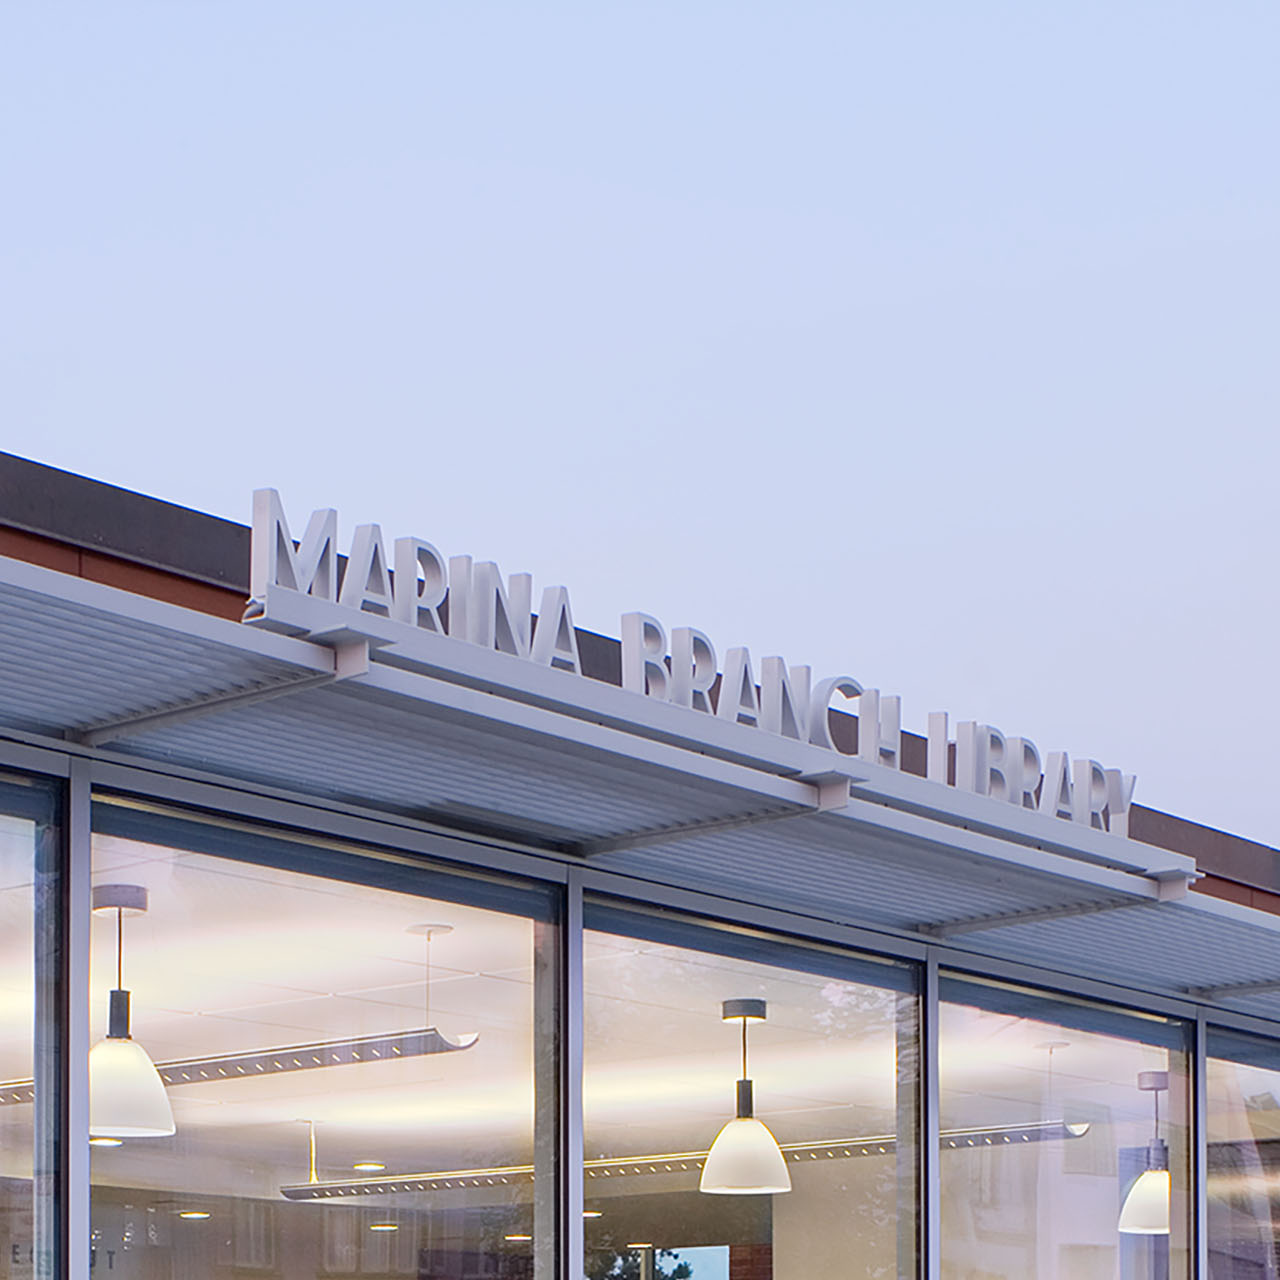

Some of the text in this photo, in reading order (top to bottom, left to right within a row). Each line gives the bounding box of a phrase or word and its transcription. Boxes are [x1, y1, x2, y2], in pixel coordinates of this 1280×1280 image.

[250, 487, 1138, 840] MARINA BRANCH LIBRARY
